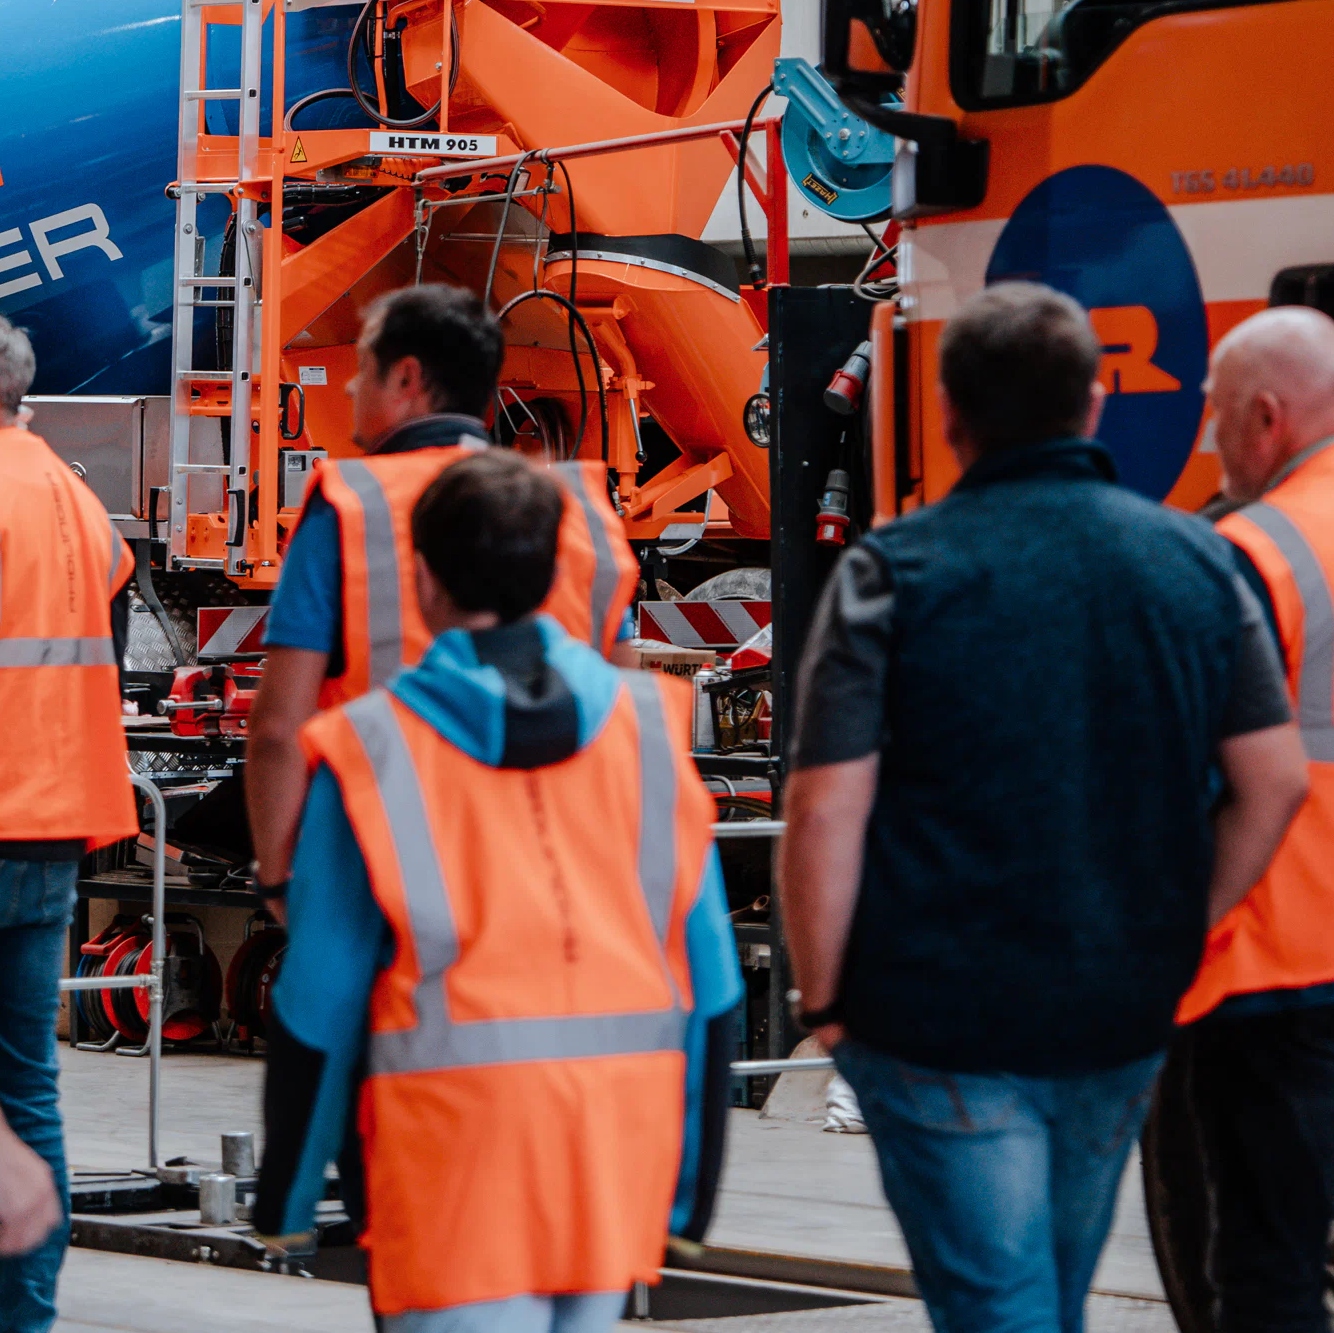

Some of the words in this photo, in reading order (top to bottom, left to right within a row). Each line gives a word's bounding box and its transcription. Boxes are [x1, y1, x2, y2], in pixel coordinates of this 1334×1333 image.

[389, 136, 440, 150] HTM
[446, 138, 478, 151] 905
[802, 173, 838, 205] HAZET
[1170, 169, 1215, 194] TGS
